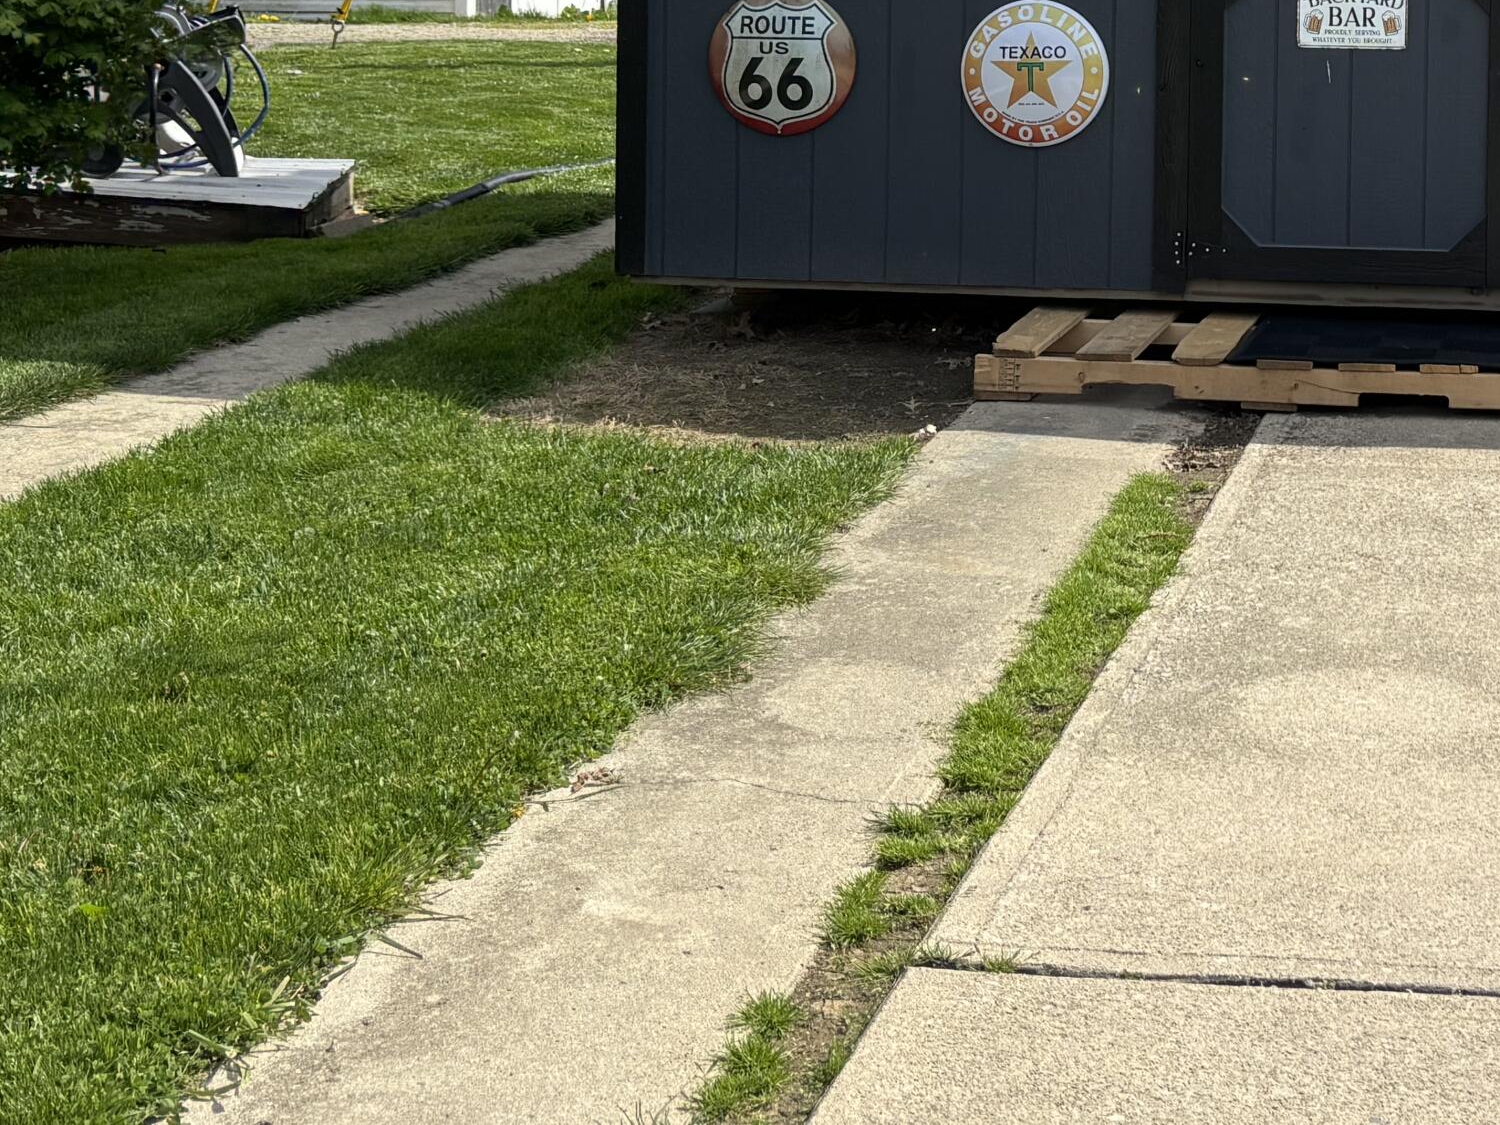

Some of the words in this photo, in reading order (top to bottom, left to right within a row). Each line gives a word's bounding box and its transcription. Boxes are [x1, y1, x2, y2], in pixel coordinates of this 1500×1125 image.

[740, 15, 816, 35] ROUTE
[1328, 6, 1376, 27] BAR
[969, 4, 1099, 60] GASOLINE
[759, 41, 789, 55] US
[999, 45, 1067, 59] TEXACO
[738, 56, 814, 111] 66
[968, 86, 1060, 141] MOTOR
[1065, 88, 1100, 126] OIL
